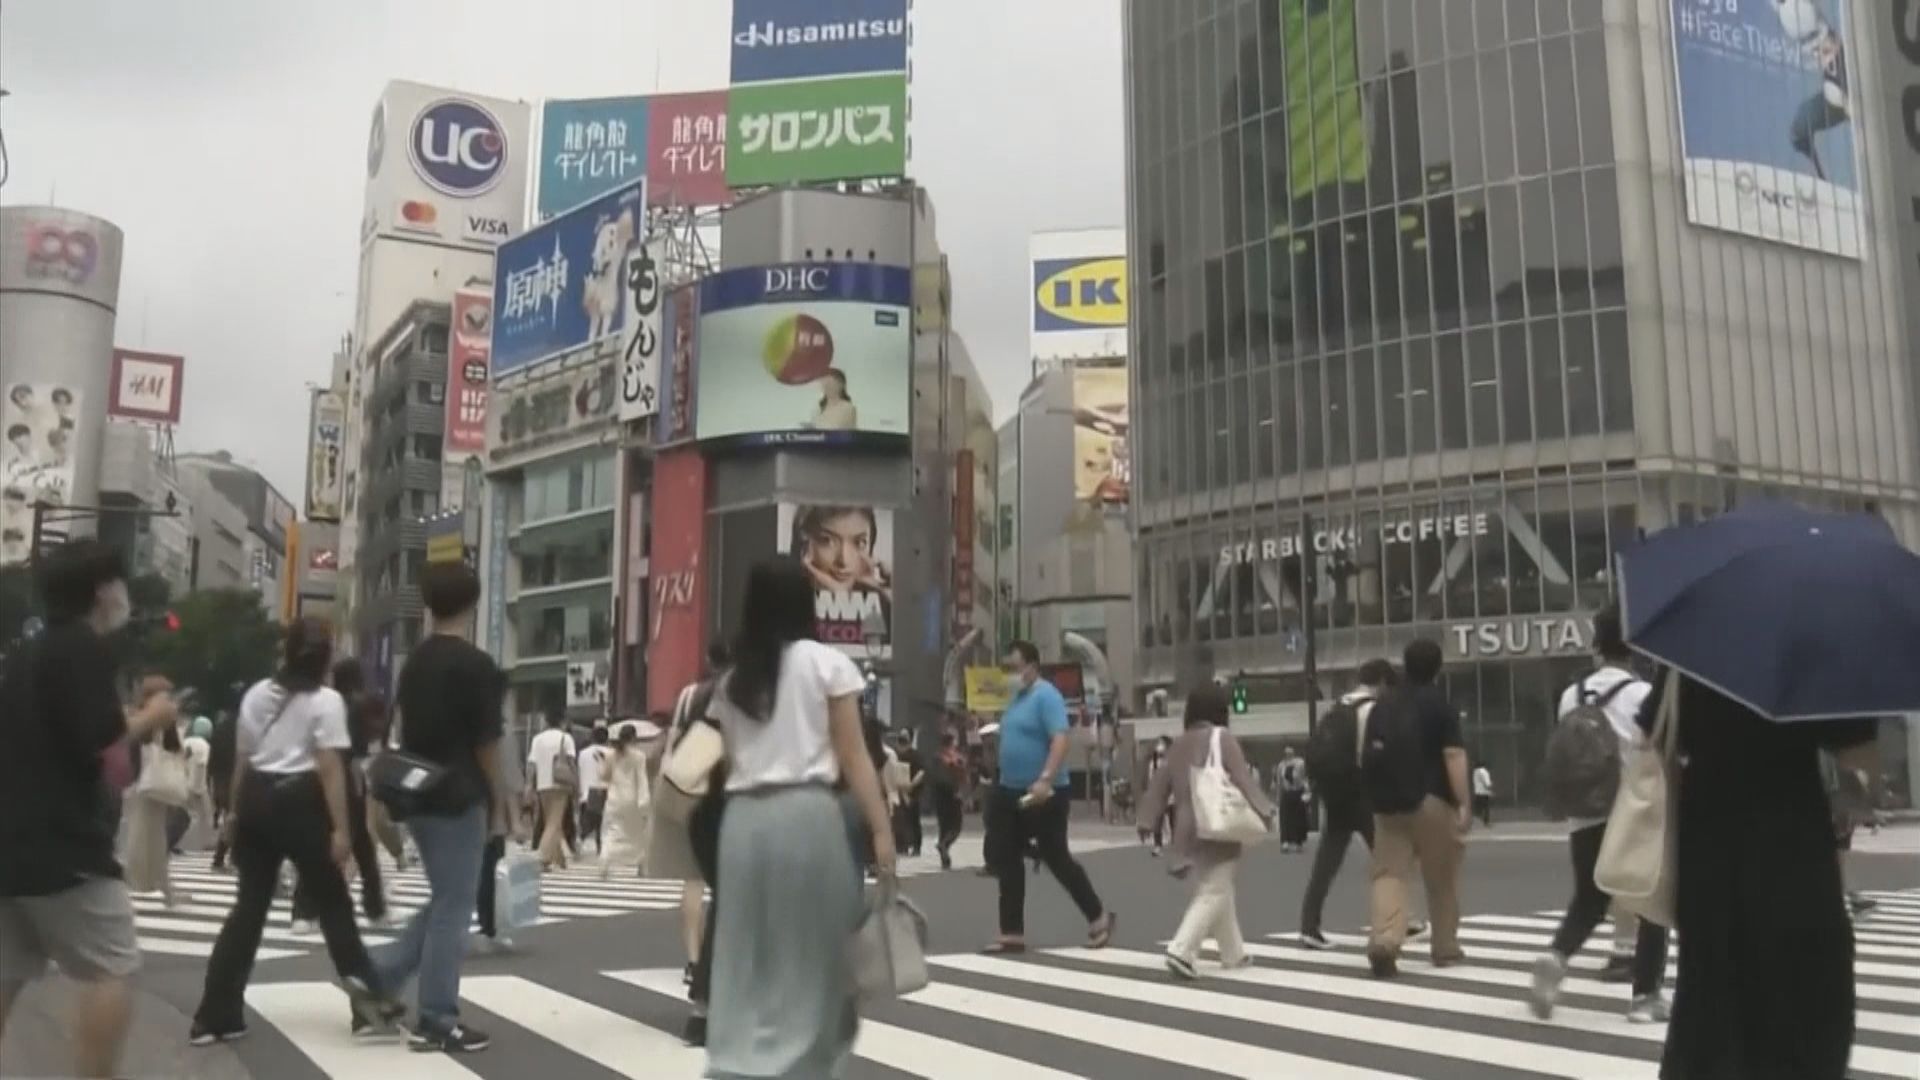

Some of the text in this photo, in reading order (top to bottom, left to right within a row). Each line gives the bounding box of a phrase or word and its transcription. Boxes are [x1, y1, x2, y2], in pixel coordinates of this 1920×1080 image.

[739, 105, 894, 154] サロンパス
[468, 216, 509, 236] VISA
[502, 232, 569, 331] 原神
[764, 268, 829, 293] DHC
[621, 245, 659, 410] もんじゃ
[1380, 513, 1489, 545] COFFEE
